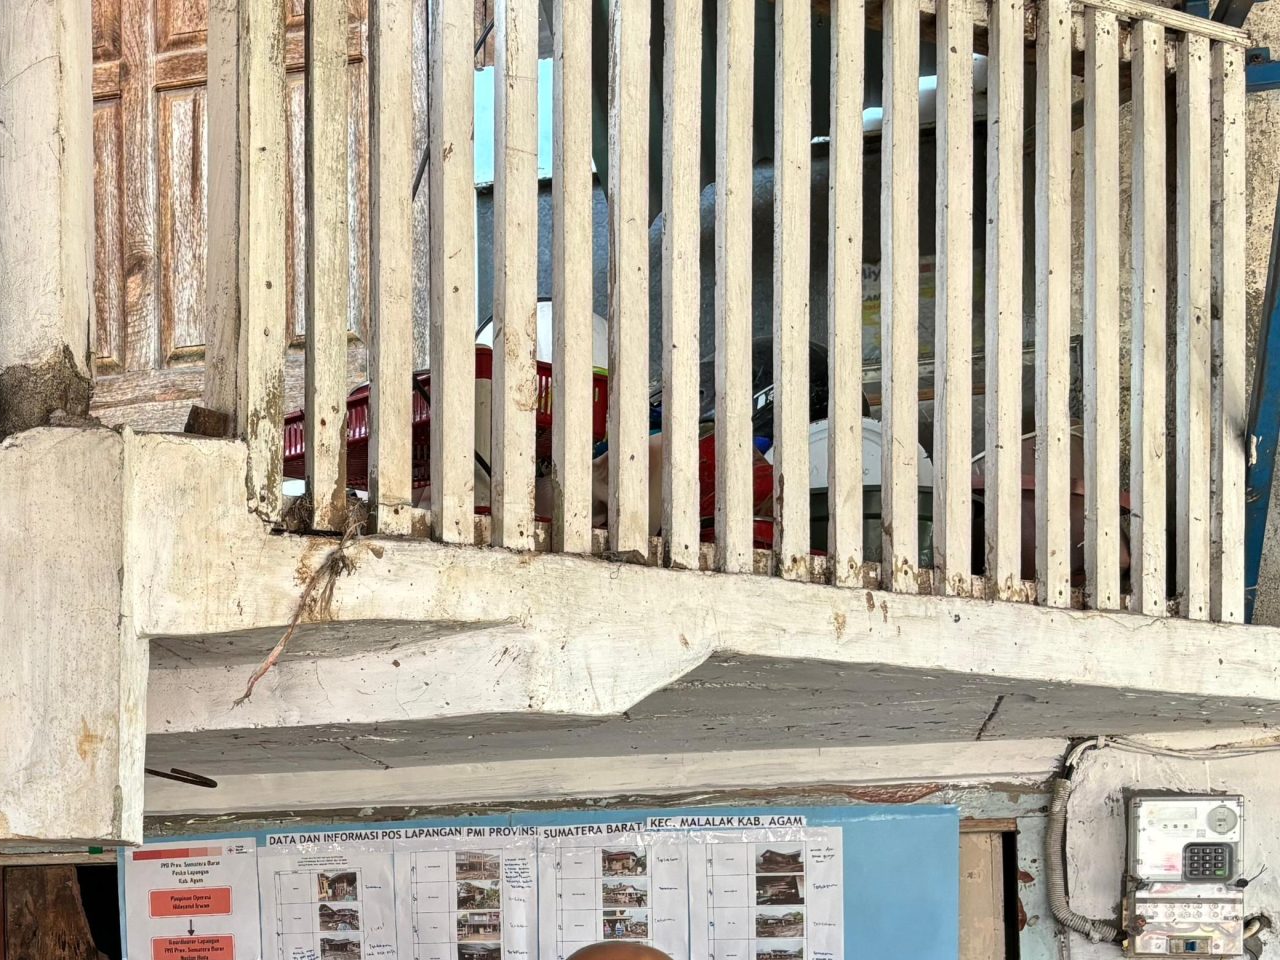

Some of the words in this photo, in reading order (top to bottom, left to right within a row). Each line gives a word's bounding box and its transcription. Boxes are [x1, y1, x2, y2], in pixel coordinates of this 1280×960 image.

[269, 835, 297, 846] DATA
[299, 834, 321, 844] DAN
[323, 831, 380, 843] INFORMASI
[381, 830, 402, 840] POS
[405, 827, 463, 839] LAPANGAN
[467, 828, 486, 838] PMI
[488, 826, 539, 838] PROVINSI
[544, 826, 605, 839] SUMATERA
[606, 823, 642, 835] BARAT
[650, 818, 676, 829] KEC.
[680, 816, 734, 828] MALALAK
[737, 816, 765, 827] KAB.
[769, 815, 803, 827] AGAM
